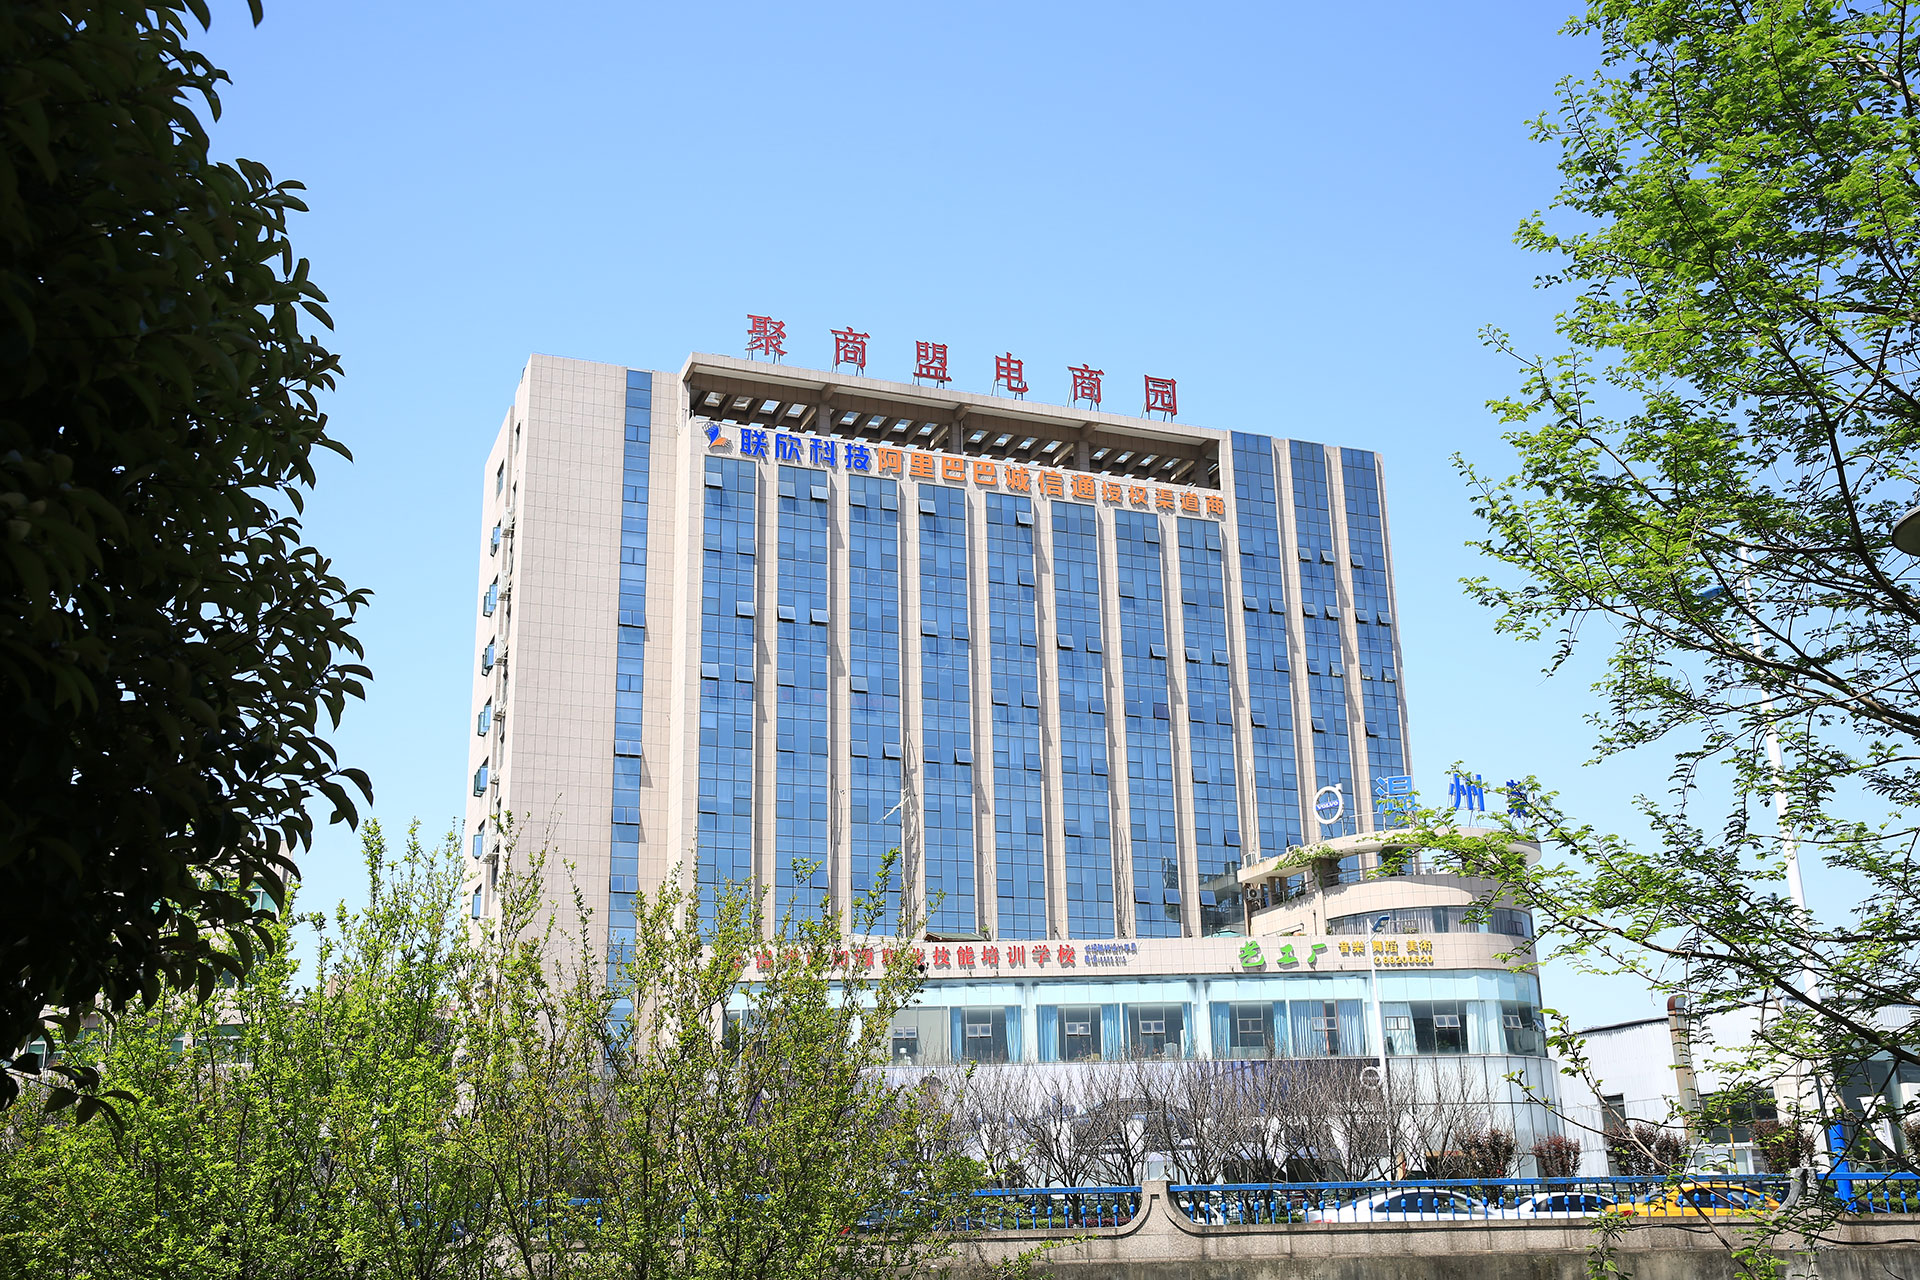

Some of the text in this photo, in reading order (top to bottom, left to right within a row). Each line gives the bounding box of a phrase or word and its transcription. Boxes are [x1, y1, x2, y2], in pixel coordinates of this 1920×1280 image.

[747, 314, 1178, 416] 聚商盟电商园
[740, 428, 1224, 515] 联欣科技 阿里巴巴诚信通授权渠道商
[1316, 800, 1339, 811] VOLVO
[1238, 940, 1328, 967] 艺工厂
[1338, 940, 1432, 953] 音樂 舞蹈 美術
[1382, 955, 1433, 964] 88200620
